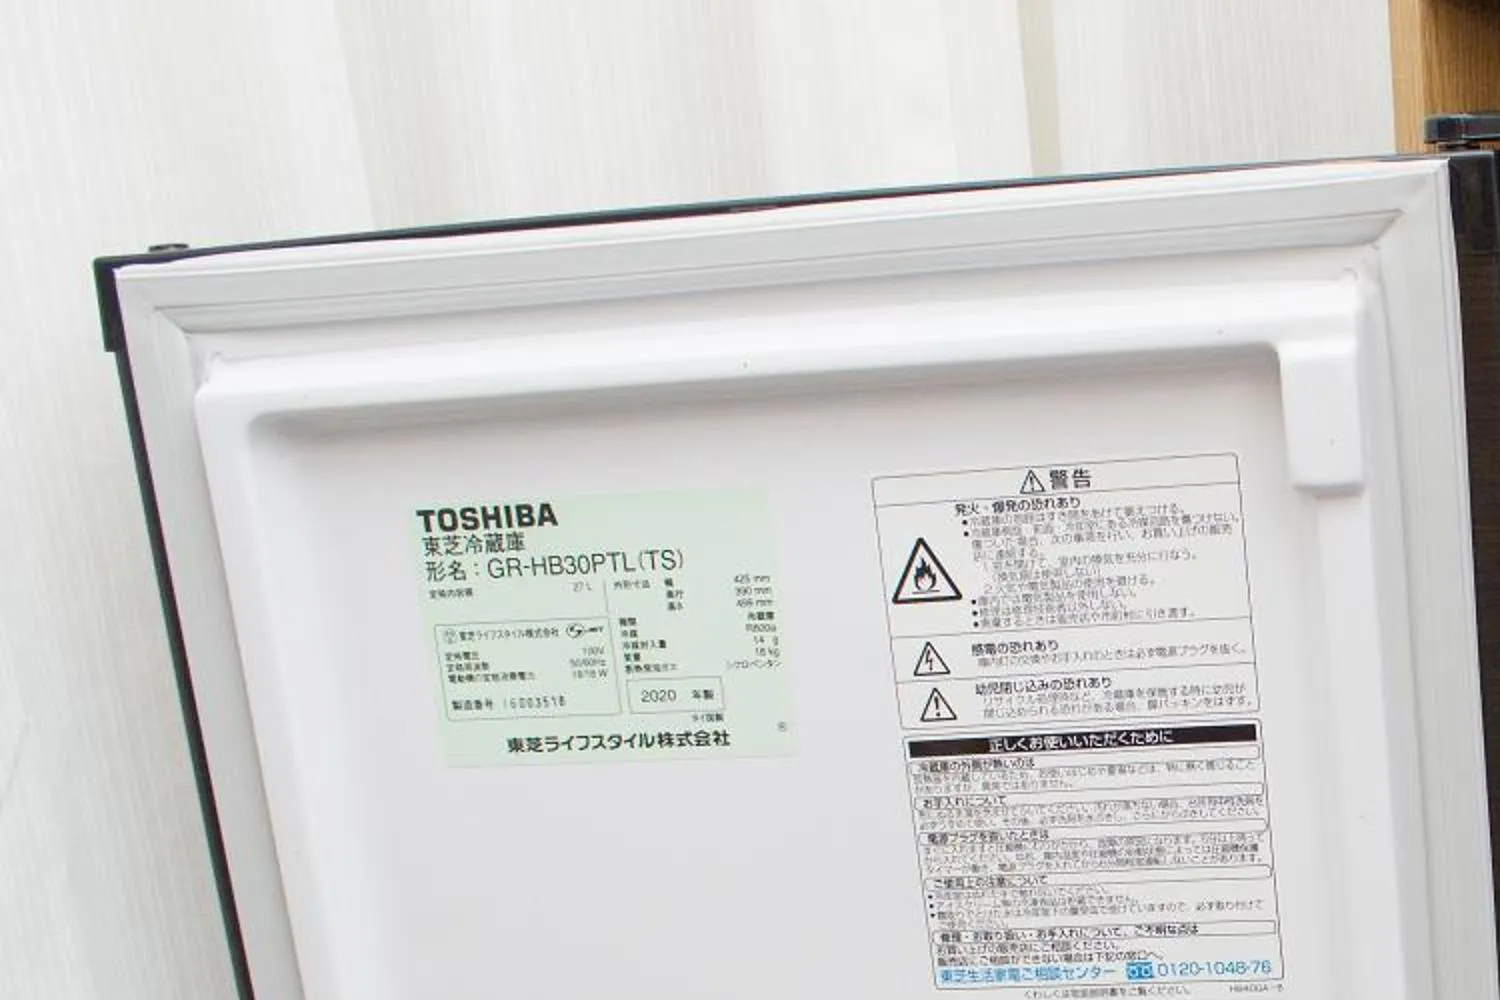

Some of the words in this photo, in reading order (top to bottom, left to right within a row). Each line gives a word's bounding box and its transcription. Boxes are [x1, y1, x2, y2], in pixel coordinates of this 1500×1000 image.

[1049, 467, 1092, 490] 警告
[416, 503, 559, 533] TOSHIBA
[422, 531, 526, 557] 東芝冷蔵庫
[487, 549, 684, 579] GR-HB30PTL(TS)
[971, 639, 1059, 657] 感電の恐れあり
[640, 689, 677, 703] 2020
[691, 689, 714, 700] 年製
[506, 730, 731, 753] 東芝ライフスタイル株式会社
[988, 730, 1175, 753] 正しくお使いいただくために
[940, 966, 1117, 984] 東芝生活家電ご相談センター
[1156, 959, 1272, 978] 0120-1048-76
